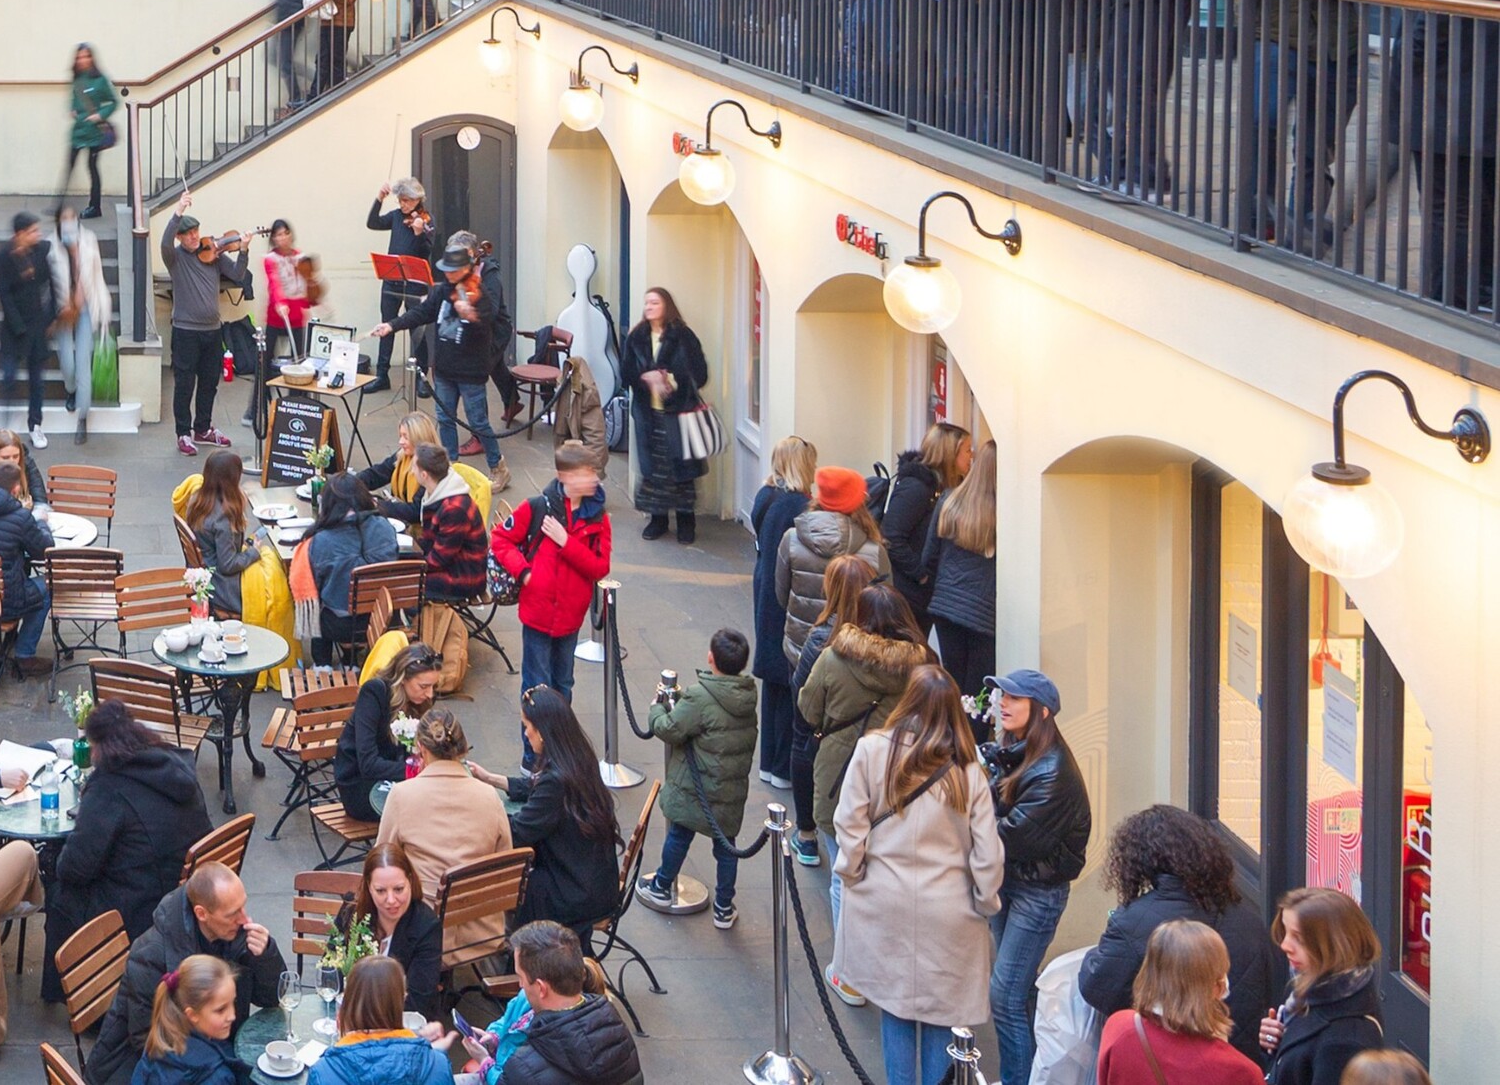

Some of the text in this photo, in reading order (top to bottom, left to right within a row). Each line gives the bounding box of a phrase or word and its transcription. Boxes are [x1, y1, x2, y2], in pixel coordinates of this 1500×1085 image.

[281, 400, 320, 412] PLEASE SUPPORT
[277, 405, 323, 419] THE PERFORMANCES
[279, 432, 290, 440] FIND
[290, 434, 300, 442] OUT
[277, 439, 294, 447] ABOUT
[272, 461, 314, 476] THANKS FOR YOUR
[281, 469, 303, 480] SUPPORT
